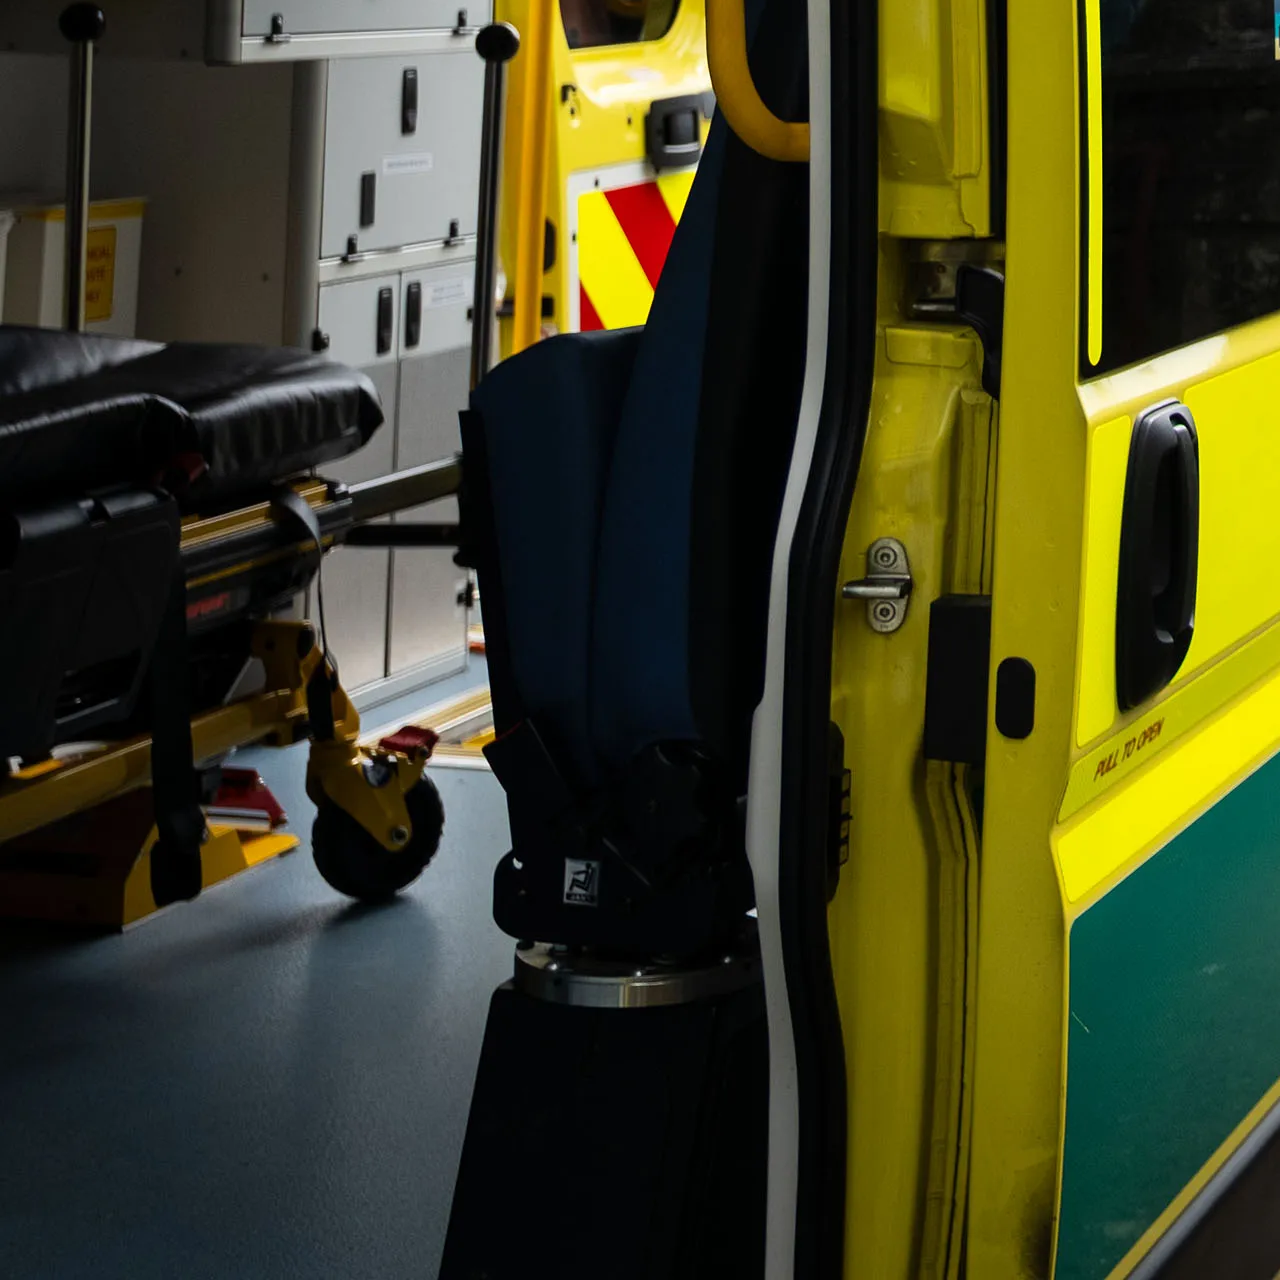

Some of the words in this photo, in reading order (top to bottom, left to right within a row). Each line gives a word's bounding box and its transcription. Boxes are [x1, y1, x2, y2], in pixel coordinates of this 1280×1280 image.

[1093, 748, 1119, 782] PULL
[1121, 737, 1136, 763] TO
[1136, 717, 1165, 751] OPEN
